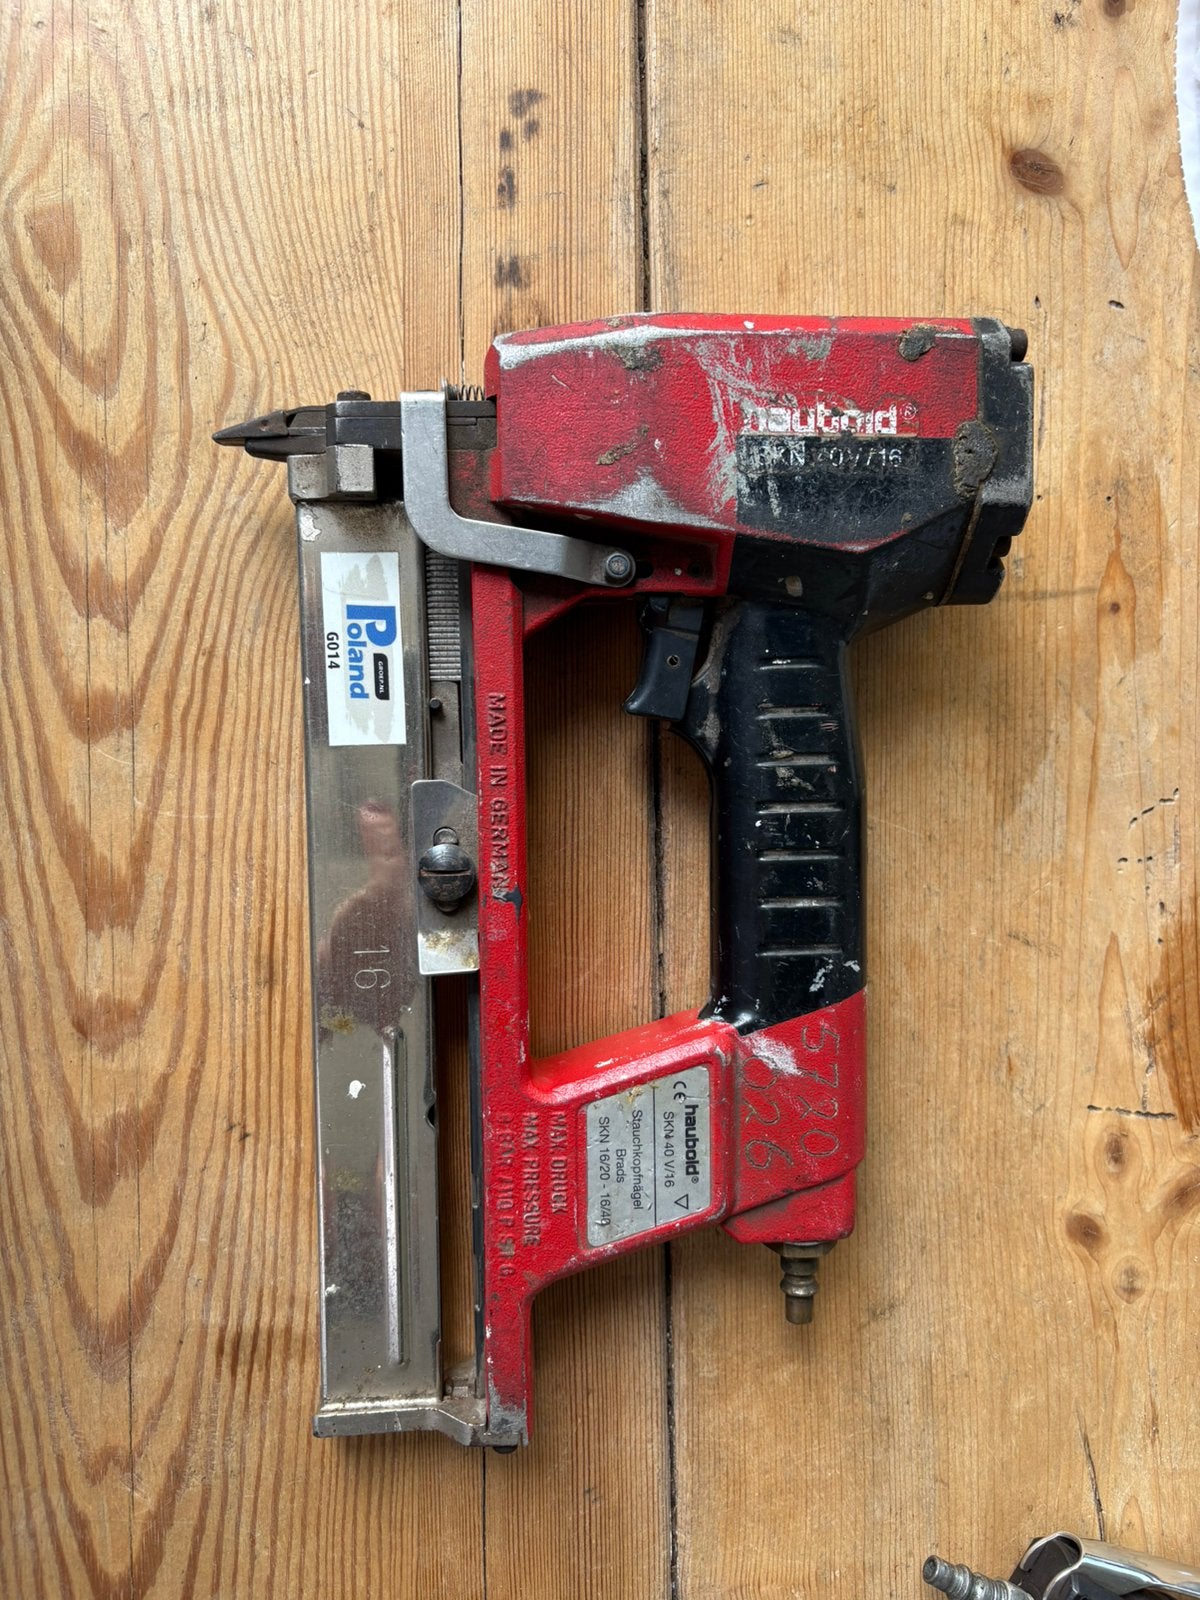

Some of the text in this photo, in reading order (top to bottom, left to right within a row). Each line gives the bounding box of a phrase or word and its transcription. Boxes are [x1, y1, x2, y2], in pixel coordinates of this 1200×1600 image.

[327, 632, 340, 669] G014
[346, 605, 397, 699] Poland
[488, 693, 509, 903] MADE IN GERMANY
[354, 945, 391, 988] 16
[743, 1055, 793, 1169] 026
[798, 1021, 840, 1157] 5720
[599, 1117, 609, 1143] SKN
[631, 1110, 643, 1210] Stauchkopfnägel
[663, 1112, 674, 1188] SKN 40 V/16
[522, 1112, 541, 1246] MAX PRESSURE
[551, 1159, 567, 1214] DRUCK
[600, 1148, 610, 1180] 16/20
[616, 1150, 626, 1183] Brads
[600, 1194, 611, 1226] 16/40
